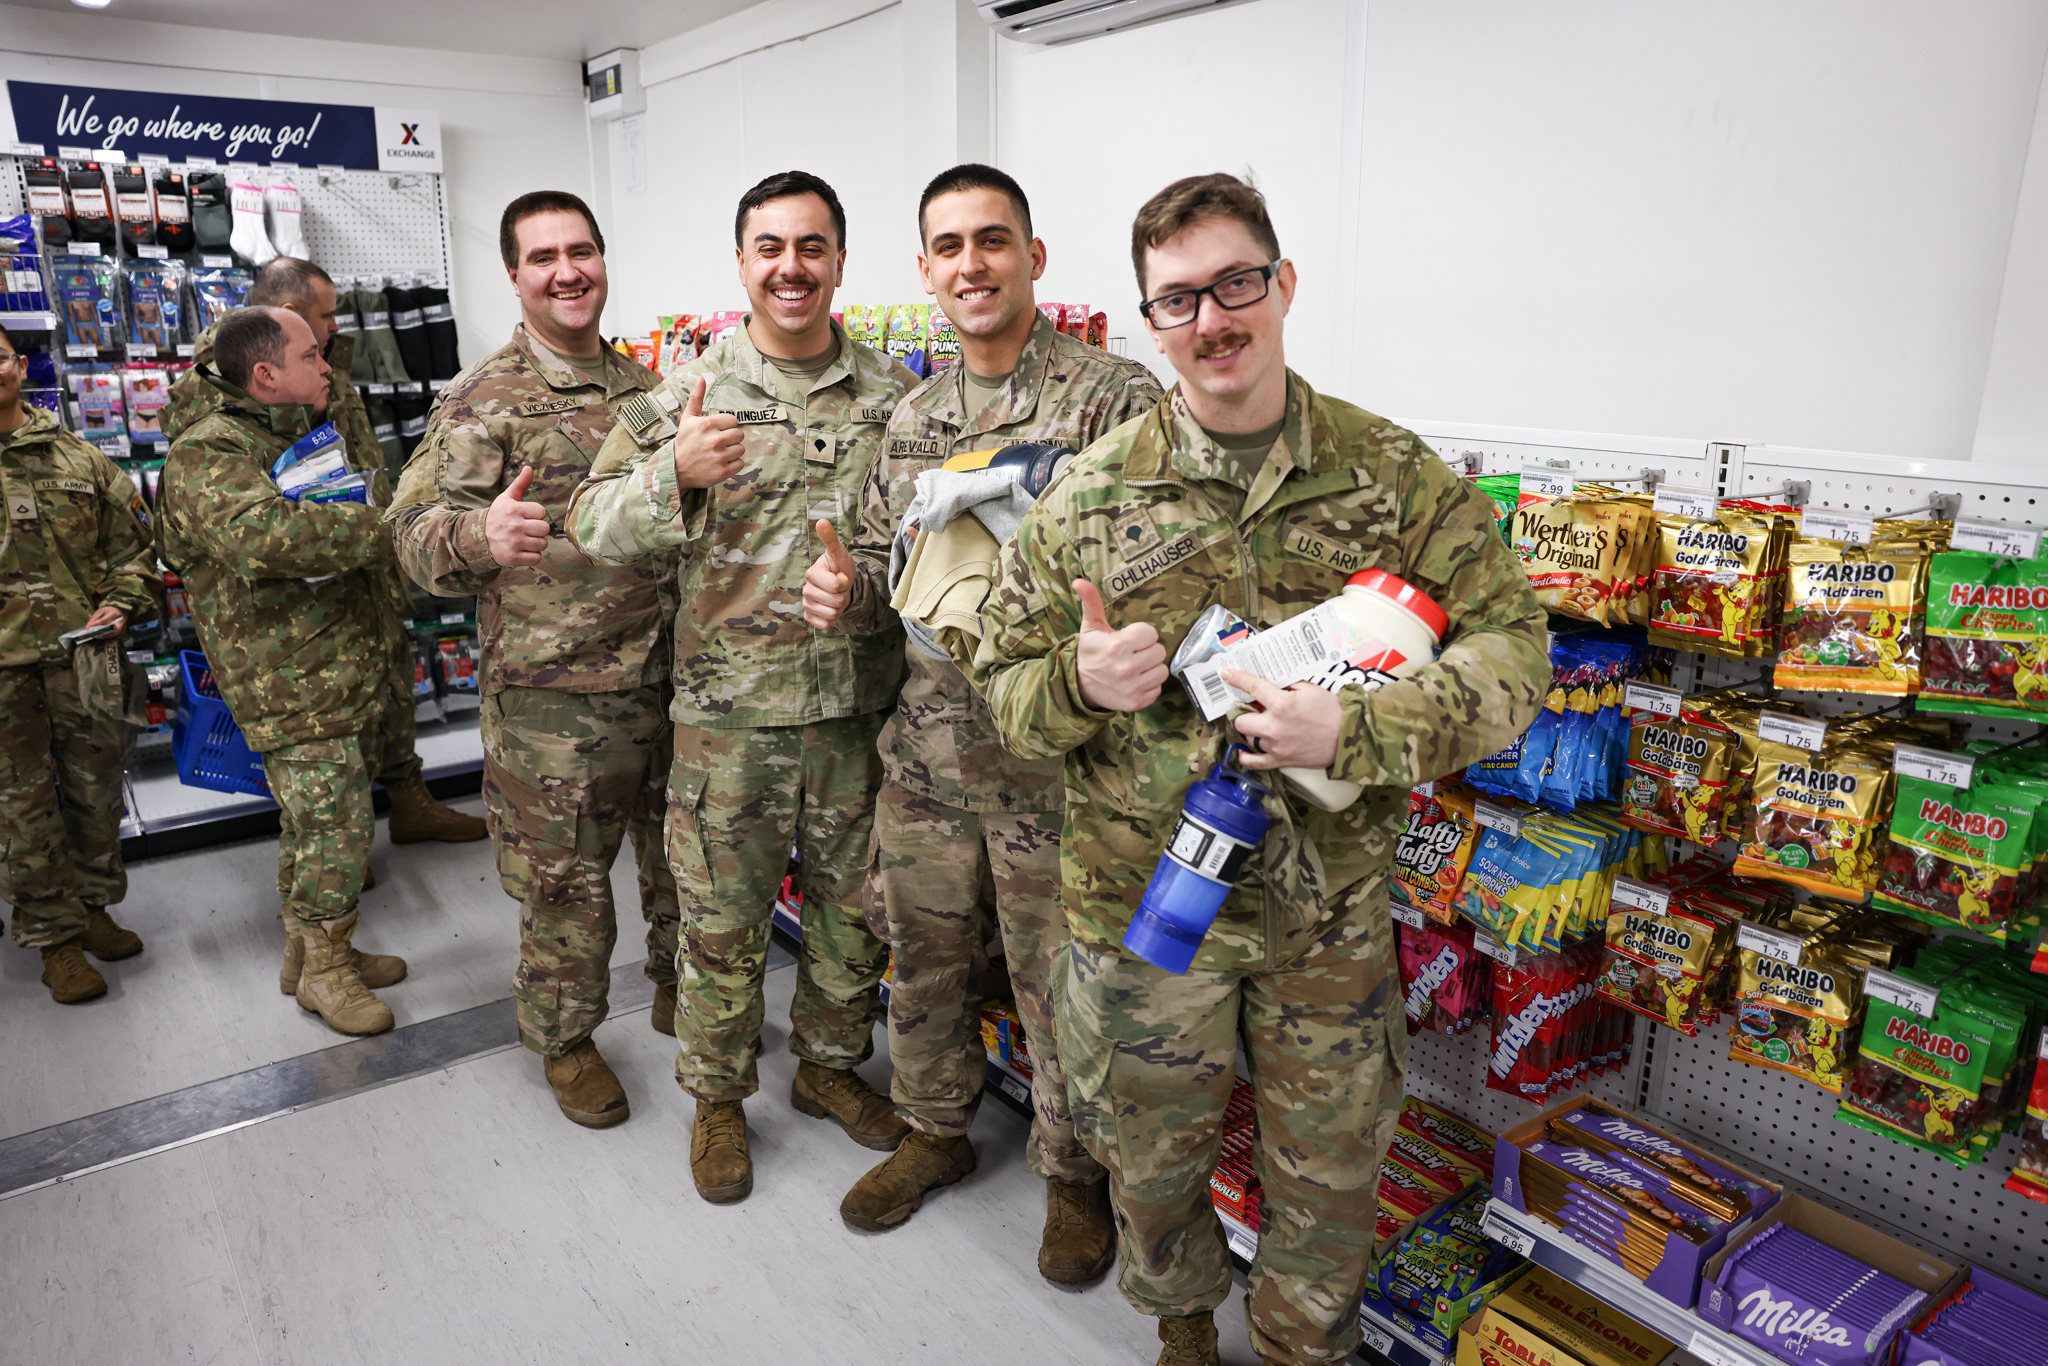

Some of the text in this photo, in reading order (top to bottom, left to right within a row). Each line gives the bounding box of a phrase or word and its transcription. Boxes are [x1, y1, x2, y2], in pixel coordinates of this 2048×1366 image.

[56, 94, 322, 158] We go where you go!
[387, 149, 435, 159] EXCHANGE
[235, 199, 260, 212] HUE
[277, 200, 298, 211] HUE
[894, 331, 913, 340] SOUR
[887, 339, 917, 356] PUNCH
[524, 397, 578, 413] VICZNESKY
[861, 409, 880, 420] U.S.
[311, 431, 328, 445] 6-12
[890, 441, 938, 454] AREVALO
[42, 480, 89, 491] U.S. ARMY
[1540, 483, 1563, 494] 2.99
[1595, 513, 1611, 521] STORCK
[1679, 504, 1704, 517] 1.75
[1520, 511, 1608, 550] Werther's
[1830, 529, 1859, 542] 1.75
[1296, 536, 1324, 561] U.S.
[1676, 528, 1749, 554] HARIBO
[1987, 541, 2022, 556] 1.75
[1535, 540, 1601, 570] Original
[1112, 537, 1196, 593] OHLHAUSER
[1807, 562, 1896, 584] HARIBO
[1529, 575, 1572, 587] Hard Candies
[1949, 583, 2048, 609] HARIBO
[1960, 613, 2035, 631] Cherries
[1980, 610, 2016, 621] Happy
[1300, 621, 1326, 662] G2
[106, 645, 118, 674] CHAVEZ
[1649, 700, 1672, 713] 1.75
[1643, 725, 1707, 758] HARIBO
[1707, 729, 1723, 737] Teilen
[1785, 734, 1811, 748] 1.75
[1642, 748, 1700, 774] Goldbären
[1858, 763, 1878, 771] Teilen
[1776, 762, 1857, 795] HARIBO
[1925, 768, 1957, 784] 1.75
[1776, 787, 1845, 809] Goldbären
[1919, 798, 2007, 841] HARIBO
[2008, 806, 2031, 816] Teilen
[1406, 812, 1463, 854] Laffy
[1491, 819, 1511, 833] 2.29
[1924, 829, 1986, 858] Cherries
[1942, 829, 1969, 848] Happy
[1395, 835, 1442, 875] Taffy
[1511, 855, 1531, 870] choice
[1410, 867, 1440, 893] COMBOS
[1478, 856, 1521, 891] SOUR NEON
[1476, 870, 1508, 898] WORMS
[1636, 897, 1659, 912] 1.75
[1399, 913, 1417, 926] 3.49
[1693, 923, 1710, 934] Teilen
[1712, 917, 1728, 927] Teilen
[1625, 914, 1692, 951] HARIBO
[1490, 948, 1509, 962] 3.49
[1623, 934, 1684, 966] Goldbären
[1762, 944, 1789, 960] 1.75
[1756, 957, 1836, 995] HARIBO
[1745, 990, 1763, 999] Saft
[1759, 981, 1824, 1008] Goldbären
[1893, 995, 1922, 1013] 1.75
[1419, 999, 1433, 1021] nibs
[1992, 1019, 2014, 1032] Teilen
[1886, 1016, 1970, 1065] HARIBO
[1971, 1033, 1991, 1046] Teilen
[1893, 1047, 1951, 1080] Cherries
[1909, 1048, 1936, 1065] Happy
[1009, 1087, 1023, 1100] 2.89
[1421, 1116, 1483, 1152] PUNCH
[1439, 1118, 1475, 1140] SOUR
[1599, 1120, 1684, 1157] Milka
[1405, 1134, 1440, 1156] SOUR
[1626, 1147, 1666, 1170] Toffee Wholenut
[1560, 1151, 1645, 1190] Milka
[1631, 1161, 1659, 1179] Toffee Wholenut
[1209, 1175, 1241, 1202] AMALES
[1586, 1179, 1626, 1203] Toffee Wholenut
[1591, 1193, 1619, 1212] Toffee Wholenut
[1587, 1205, 1614, 1224] Toffee Wholenut
[1579, 1222, 1606, 1241] Toffee Wholenut
[1587, 1216, 1615, 1235] Toffee Wholenut
[1452, 1228, 1482, 1243] MINI BITES
[1501, 1235, 1524, 1253] 6.95
[1431, 1246, 1460, 1262] SOUR
[1584, 1238, 1612, 1257] Toffee Wholenut
[1394, 1253, 1443, 1290] PUNCH
[1408, 1254, 1435, 1272] SOUR
[1397, 1268, 1411, 1281] MINI
[1411, 1276, 1426, 1288] BITES
[1392, 1313, 1417, 1333] PUNCH
[1521, 1278, 1654, 1362] TOBLERONE
[1737, 1288, 1852, 1347] Milka
[1366, 1333, 1384, 1351] 1.99
